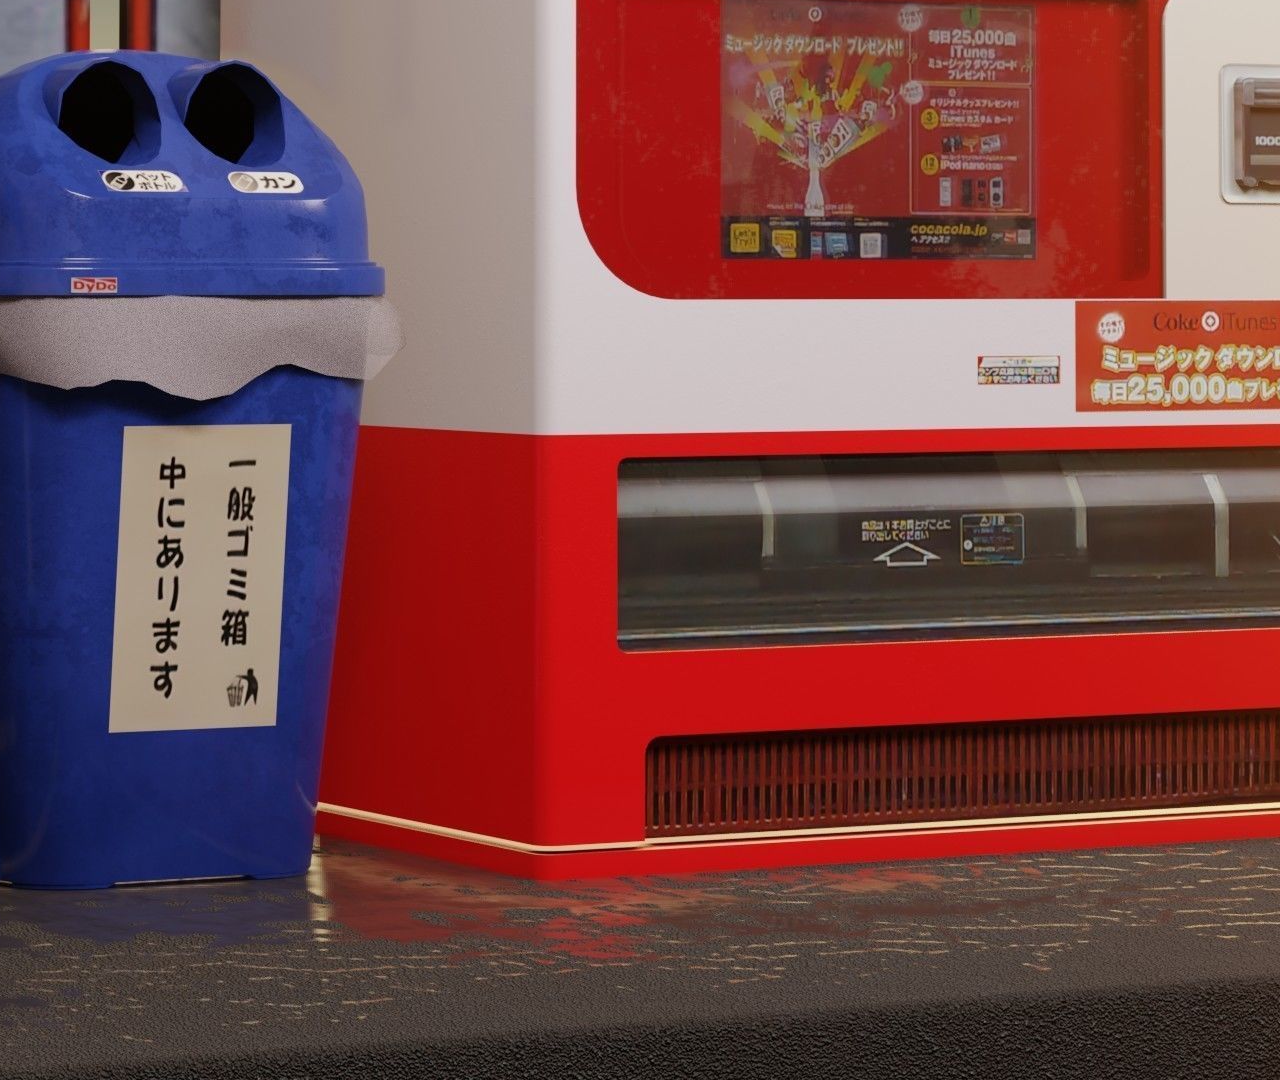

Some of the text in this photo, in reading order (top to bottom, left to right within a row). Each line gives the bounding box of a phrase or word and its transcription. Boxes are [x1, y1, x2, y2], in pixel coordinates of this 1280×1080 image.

[259, 175, 296, 190] カン
[73, 280, 117, 293] DyDo
[1152, 310, 1278, 333] Coke iTunes
[1101, 343, 1214, 372] ミュージック
[221, 458, 257, 647] 一般ゴミ箱
[150, 455, 187, 700] 中にあります
